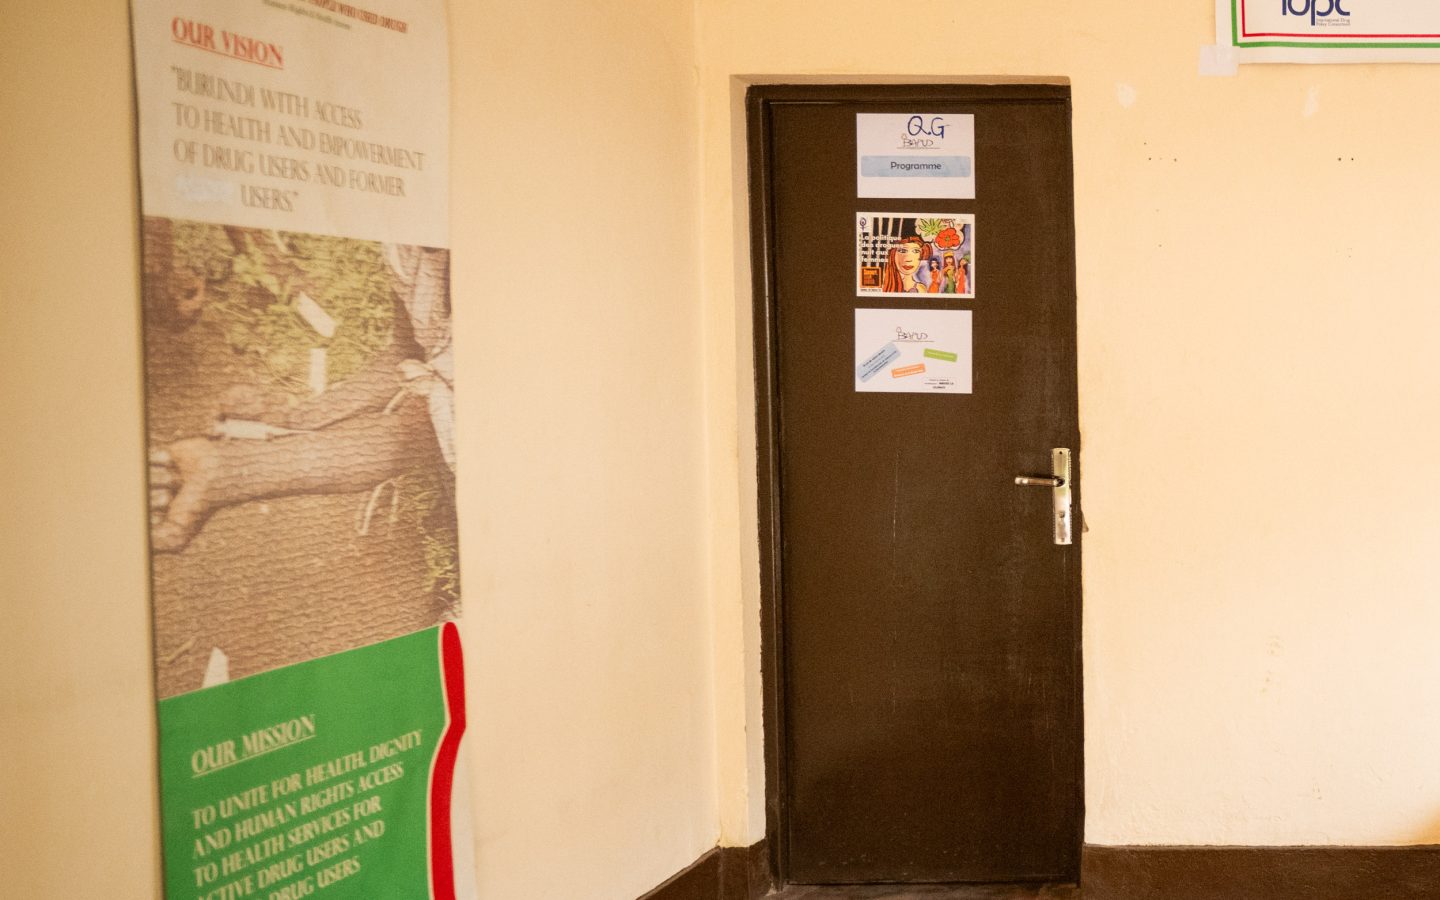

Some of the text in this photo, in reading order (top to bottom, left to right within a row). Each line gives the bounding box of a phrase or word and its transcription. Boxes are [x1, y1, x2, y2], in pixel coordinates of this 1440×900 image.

[172, 16, 283, 66] OUR VISION
[172, 102, 426, 171] TO HEALTH AND EMPOWERMENT
[260, 89, 309, 118] WITH
[314, 102, 363, 129] ACCESS
[173, 140, 406, 197] OF DRUG USERS AND FORMER
[890, 161, 942, 171] Programme
[871, 234, 902, 243] politique
[191, 713, 316, 774] OUR MISSION
[192, 806, 216, 829] TO
[219, 786, 269, 816] UNITE
[271, 775, 304, 799] FOR
[369, 729, 423, 762] DIGNITY
[192, 762, 404, 859] AND HUMAN RIGHTS ACCESS
[192, 795, 382, 887] TO HEALTH SERVICES FOR
[198, 820, 385, 900] CTIVE DRUG USERS AND
[268, 855, 361, 900] DRUG USERS
